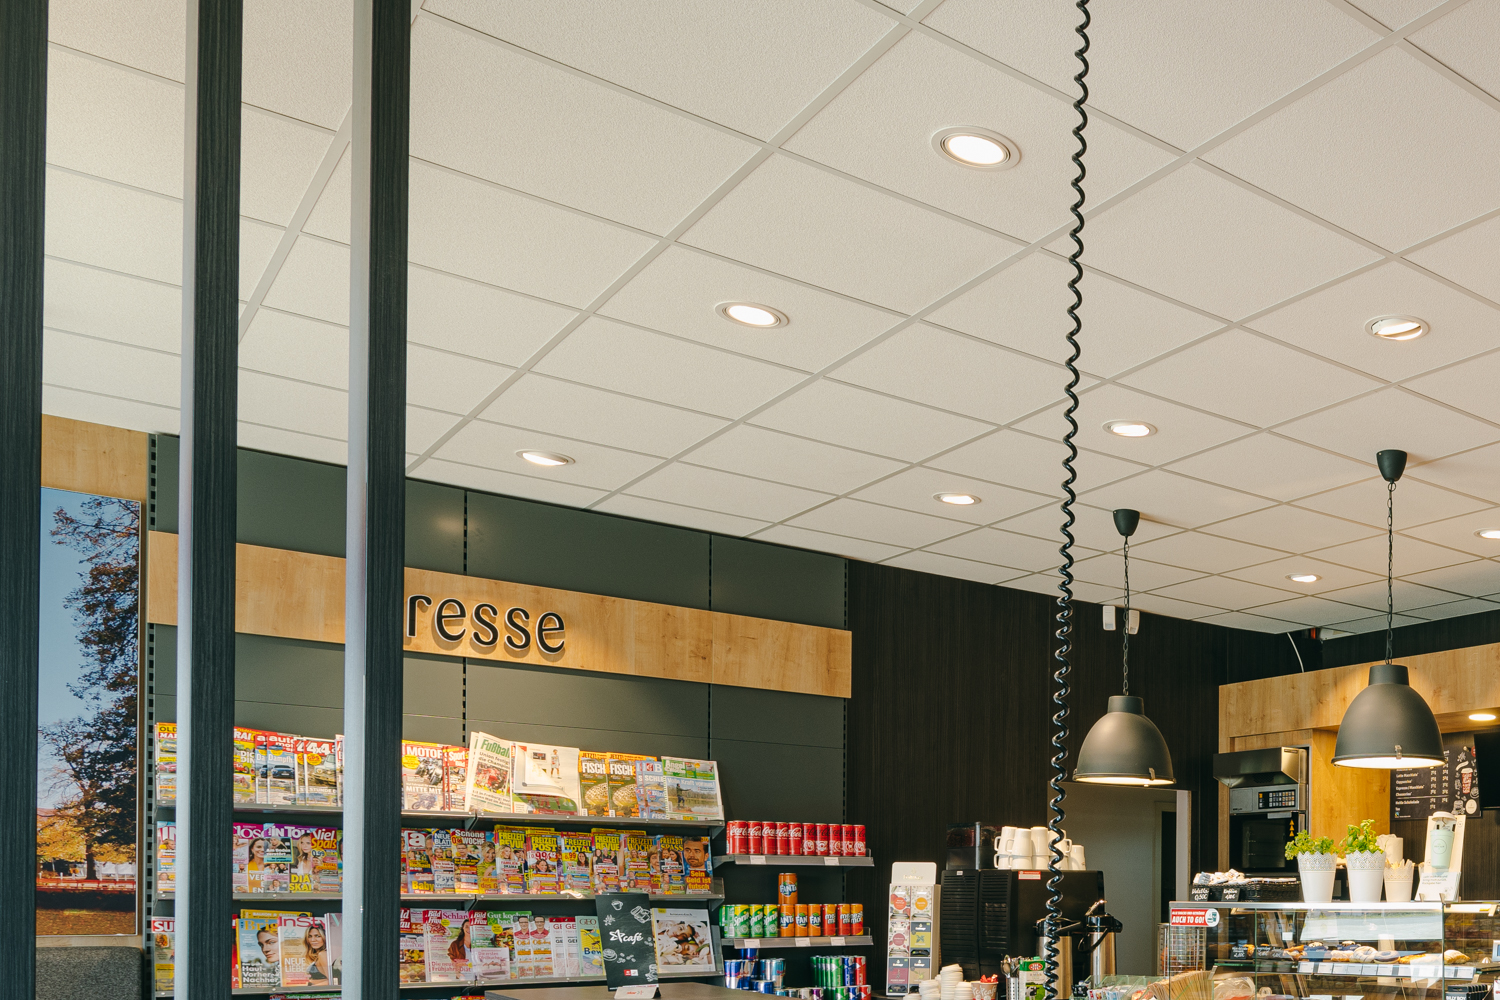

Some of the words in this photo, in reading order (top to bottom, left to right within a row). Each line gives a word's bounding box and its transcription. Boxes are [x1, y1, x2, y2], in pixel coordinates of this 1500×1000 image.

[406, 594, 565, 655] resse
[306, 742, 331, 755] 4x4
[313, 830, 335, 841] Viel
[311, 839, 337, 850] Spaß
[412, 881, 434, 891] Baby
[623, 932, 644, 945] café
[284, 957, 305, 966] NEUE
[285, 965, 305, 973] LIEBE
